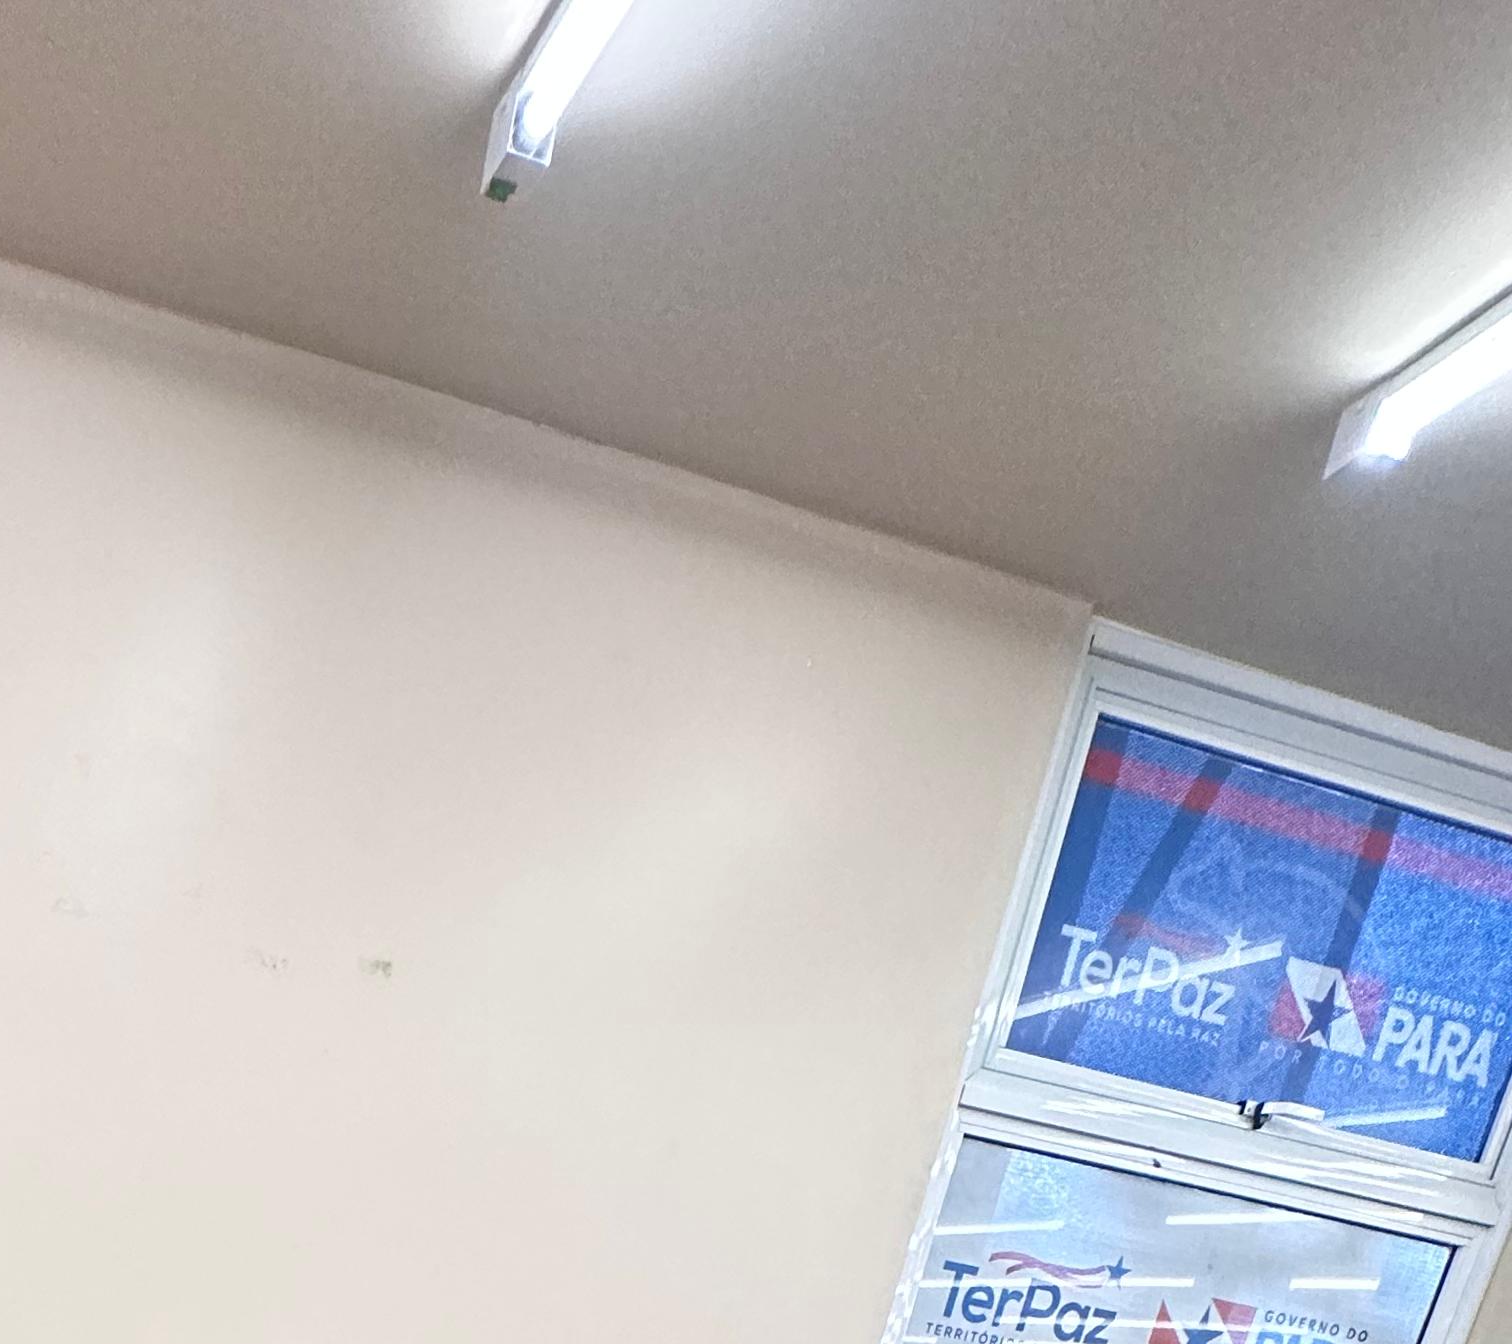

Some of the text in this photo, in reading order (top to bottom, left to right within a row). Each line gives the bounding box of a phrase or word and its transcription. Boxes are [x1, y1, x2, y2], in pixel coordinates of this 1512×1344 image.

[1060, 923, 1236, 1026] TerPaz
[1259, 1040, 1303, 1065] POR
[1264, 1309, 1369, 1343] GOVERNO DO
